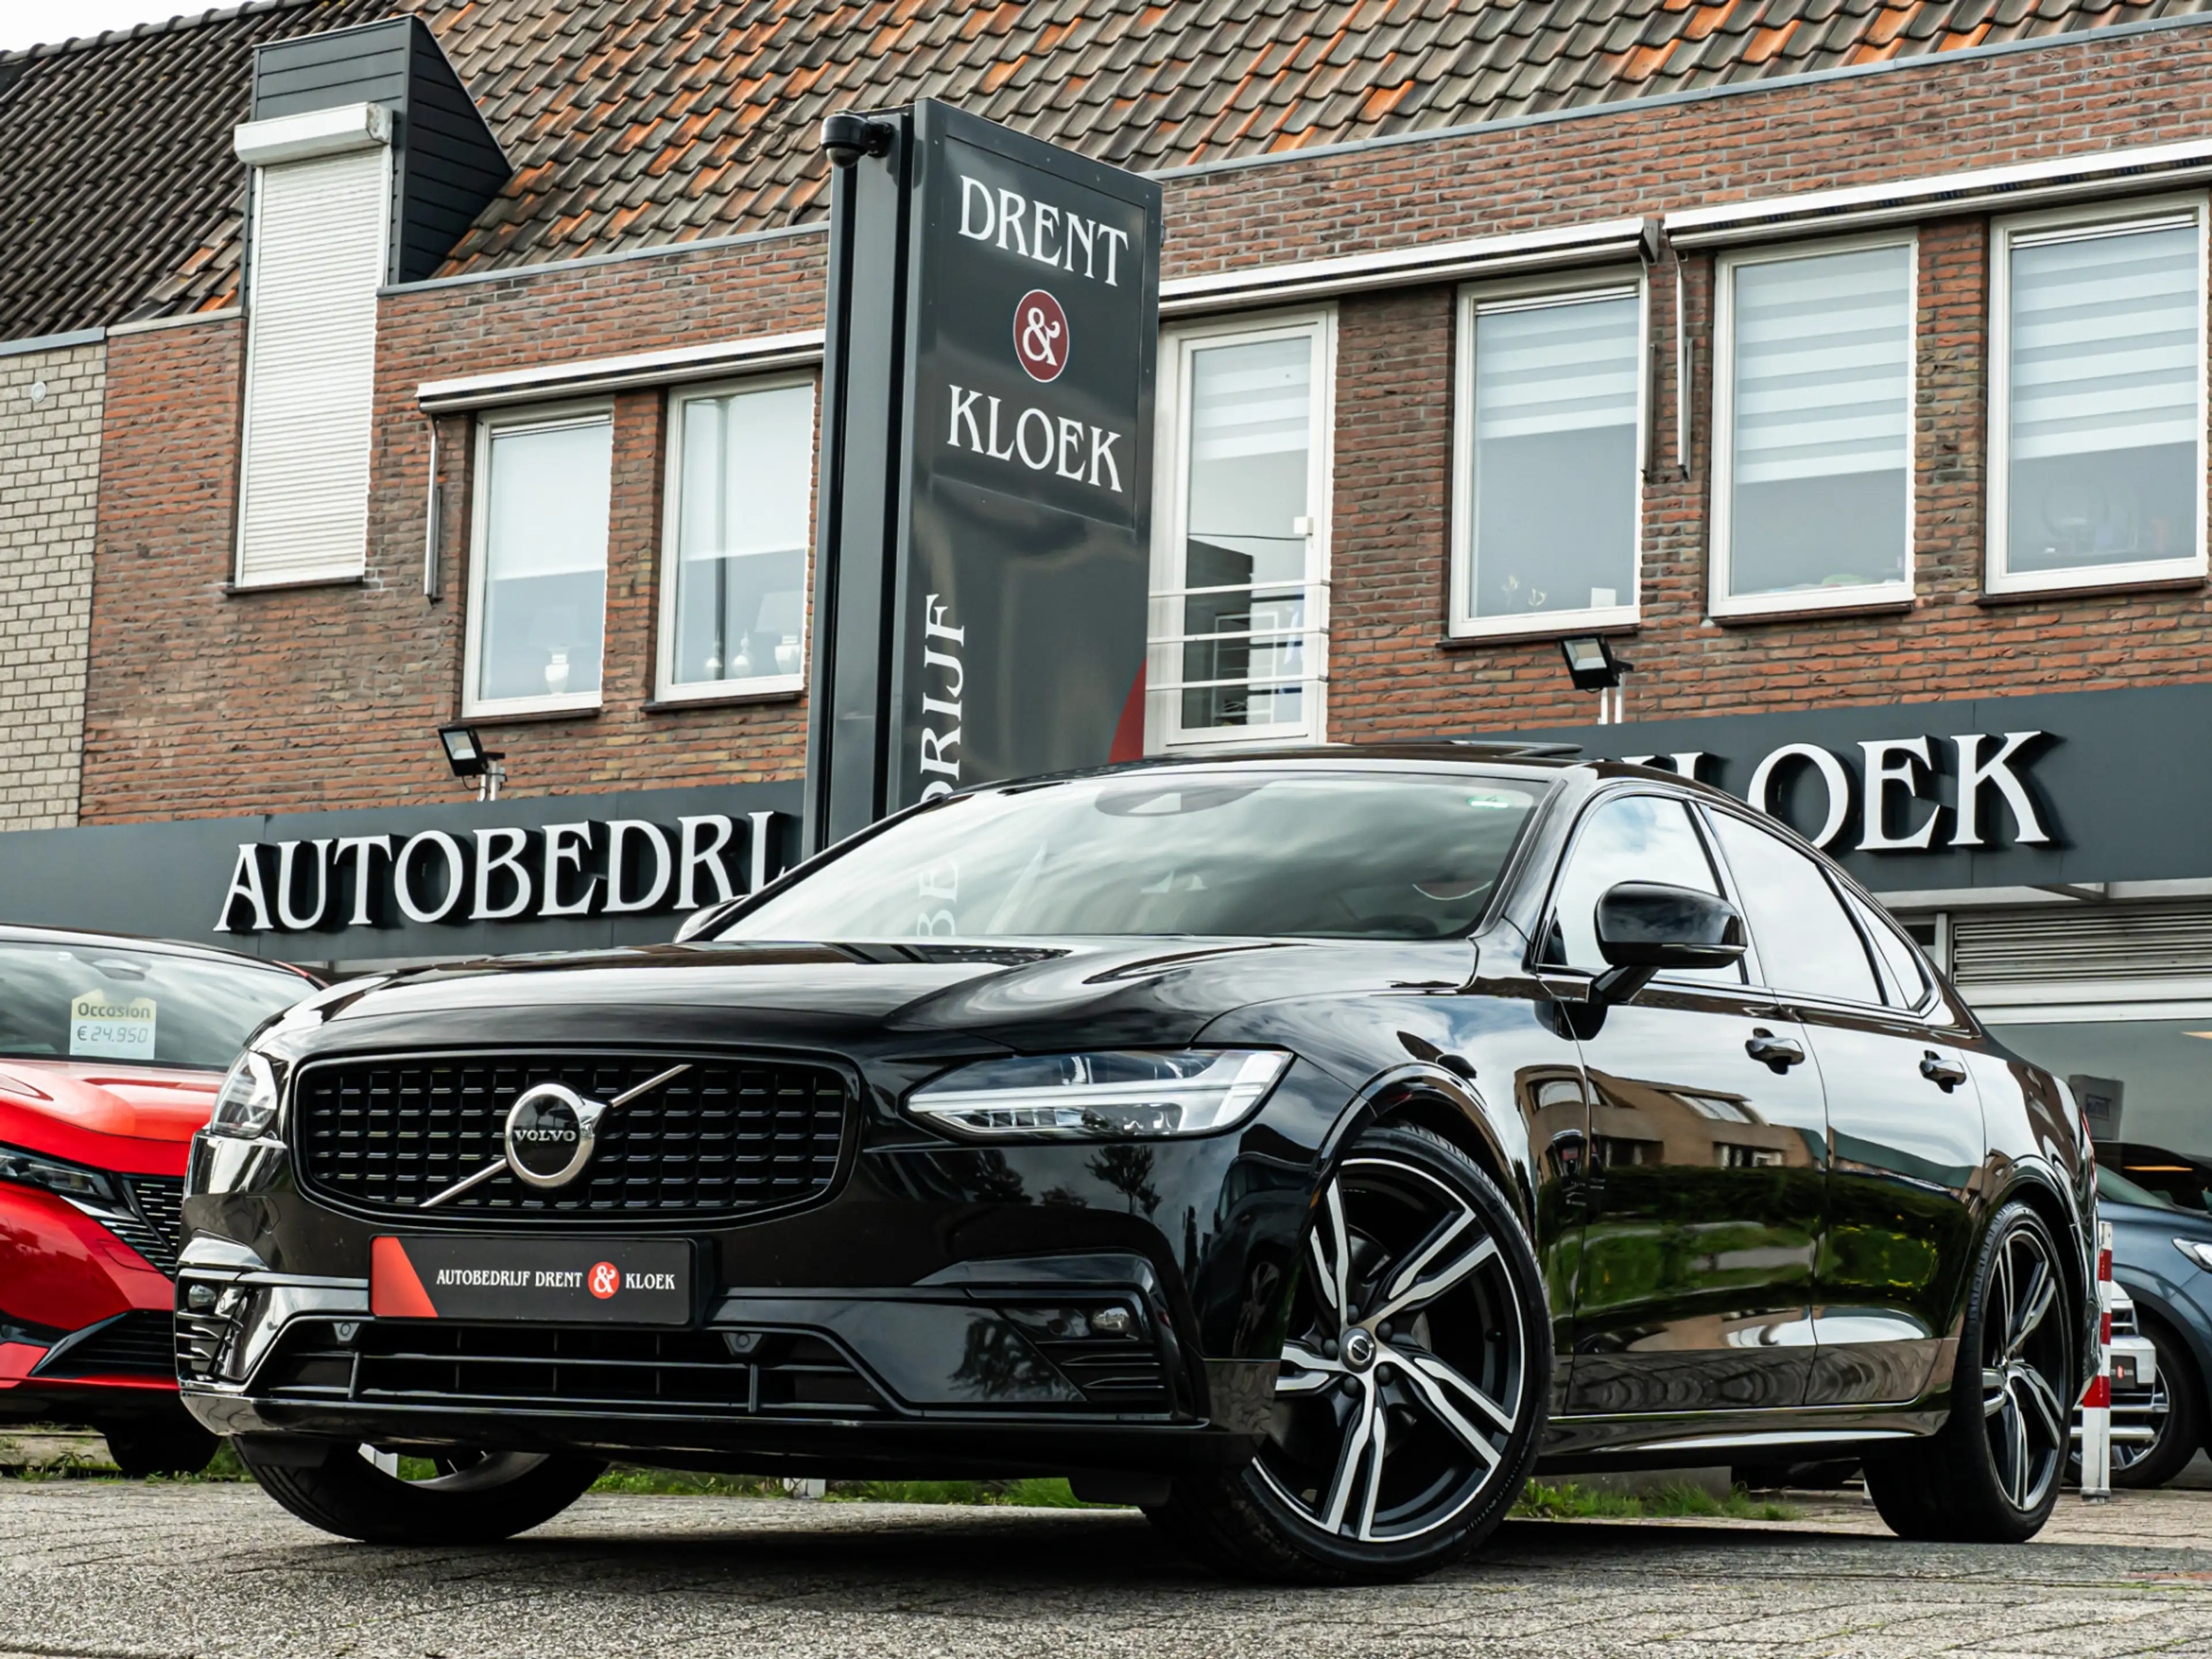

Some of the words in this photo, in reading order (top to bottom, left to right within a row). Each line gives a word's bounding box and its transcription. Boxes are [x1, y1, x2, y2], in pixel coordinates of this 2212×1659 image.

[958, 175, 1129, 287] DRENT
[1022, 306, 1061, 367] &
[948, 384, 1123, 493] KLOEK
[213, 810, 786, 933] AUTOBEDRI
[78, 1002, 150, 1018] Occasion
[514, 1130, 577, 1142] VOLVO
[436, 1269, 531, 1287] AUTOBEDRIJF
[535, 1271, 583, 1289] DRENT
[593, 1266, 616, 1293] &
[626, 1272, 676, 1290] KLOEK
